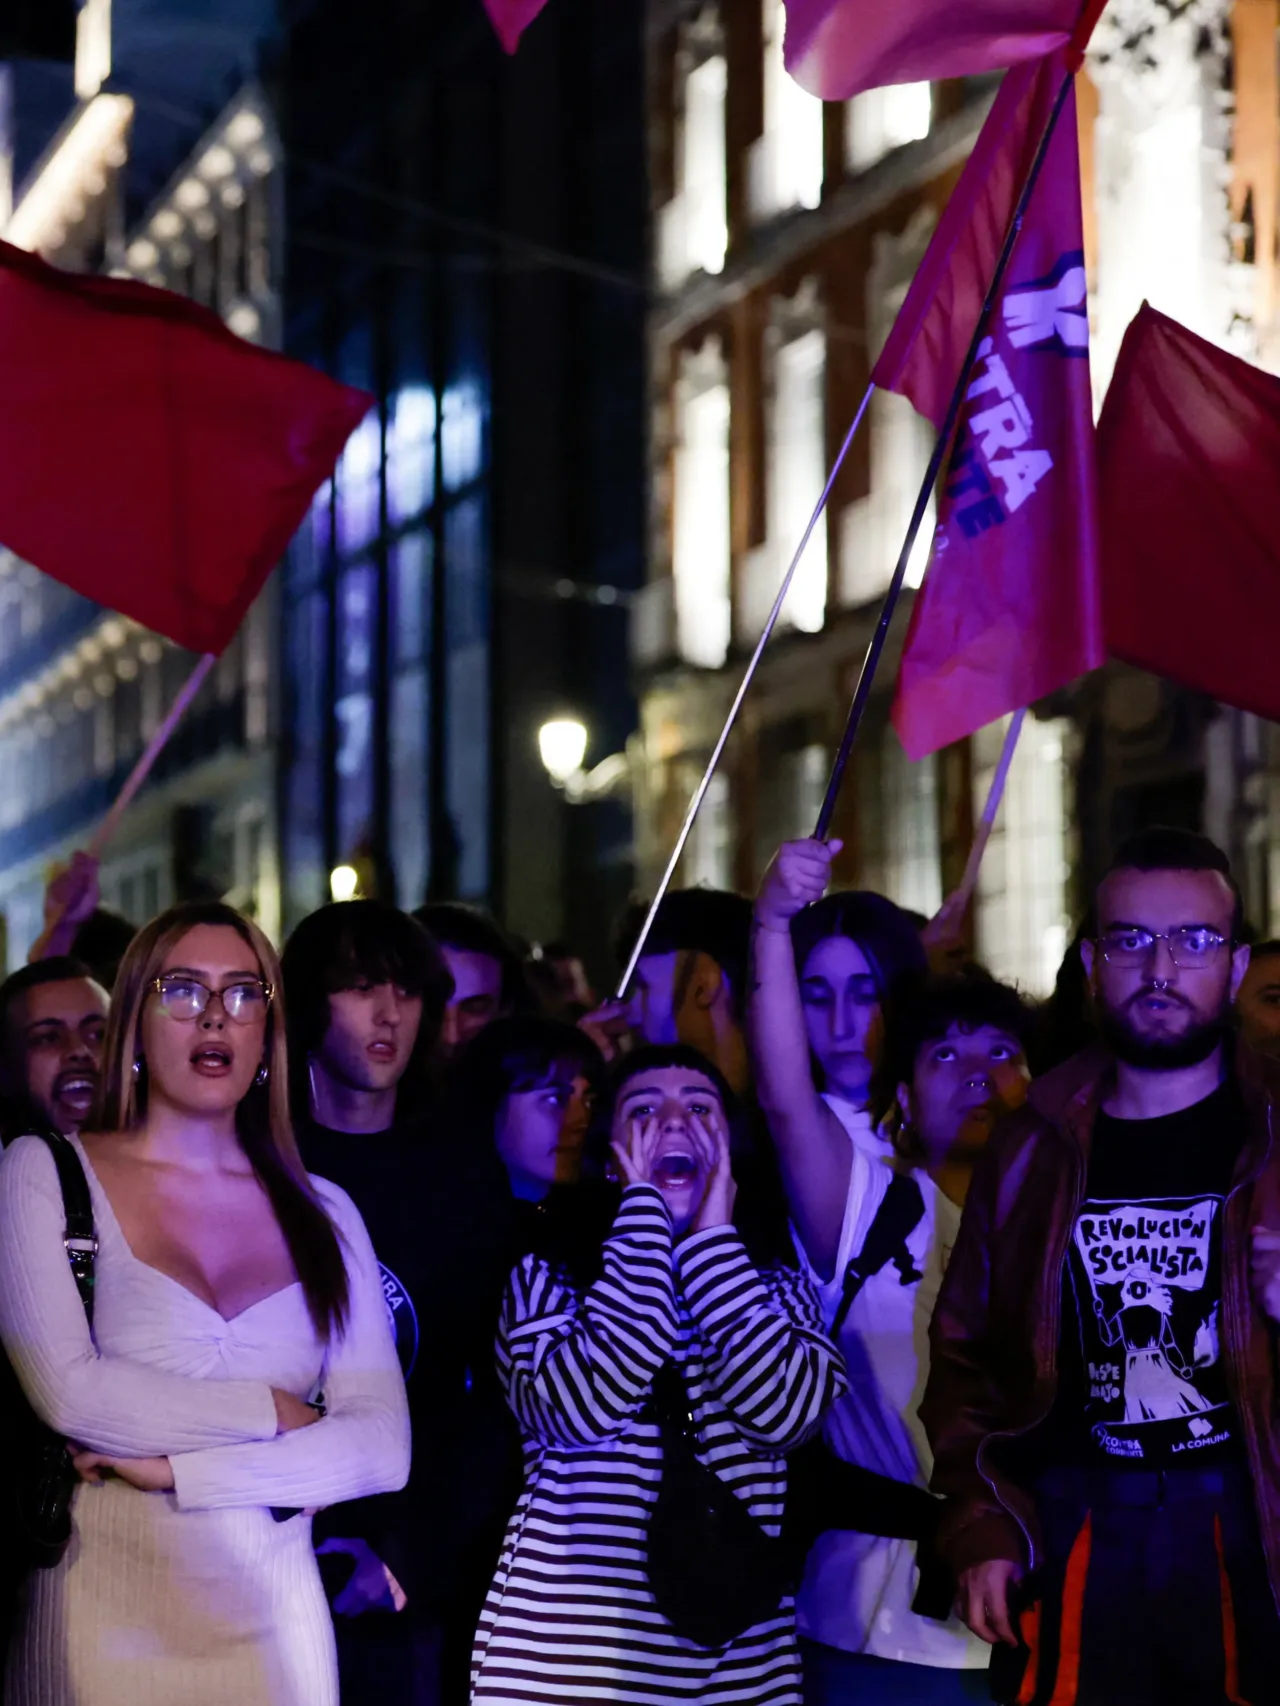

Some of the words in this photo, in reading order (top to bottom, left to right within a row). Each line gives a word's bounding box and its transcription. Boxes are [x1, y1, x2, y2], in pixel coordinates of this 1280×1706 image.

[1080, 1211, 1207, 1246] REVOLUCIÓN
[1088, 1245, 1204, 1279] SOCIALISTA
[1172, 1443, 1185, 1453] LA
[1187, 1430, 1230, 1449] COMUNA
